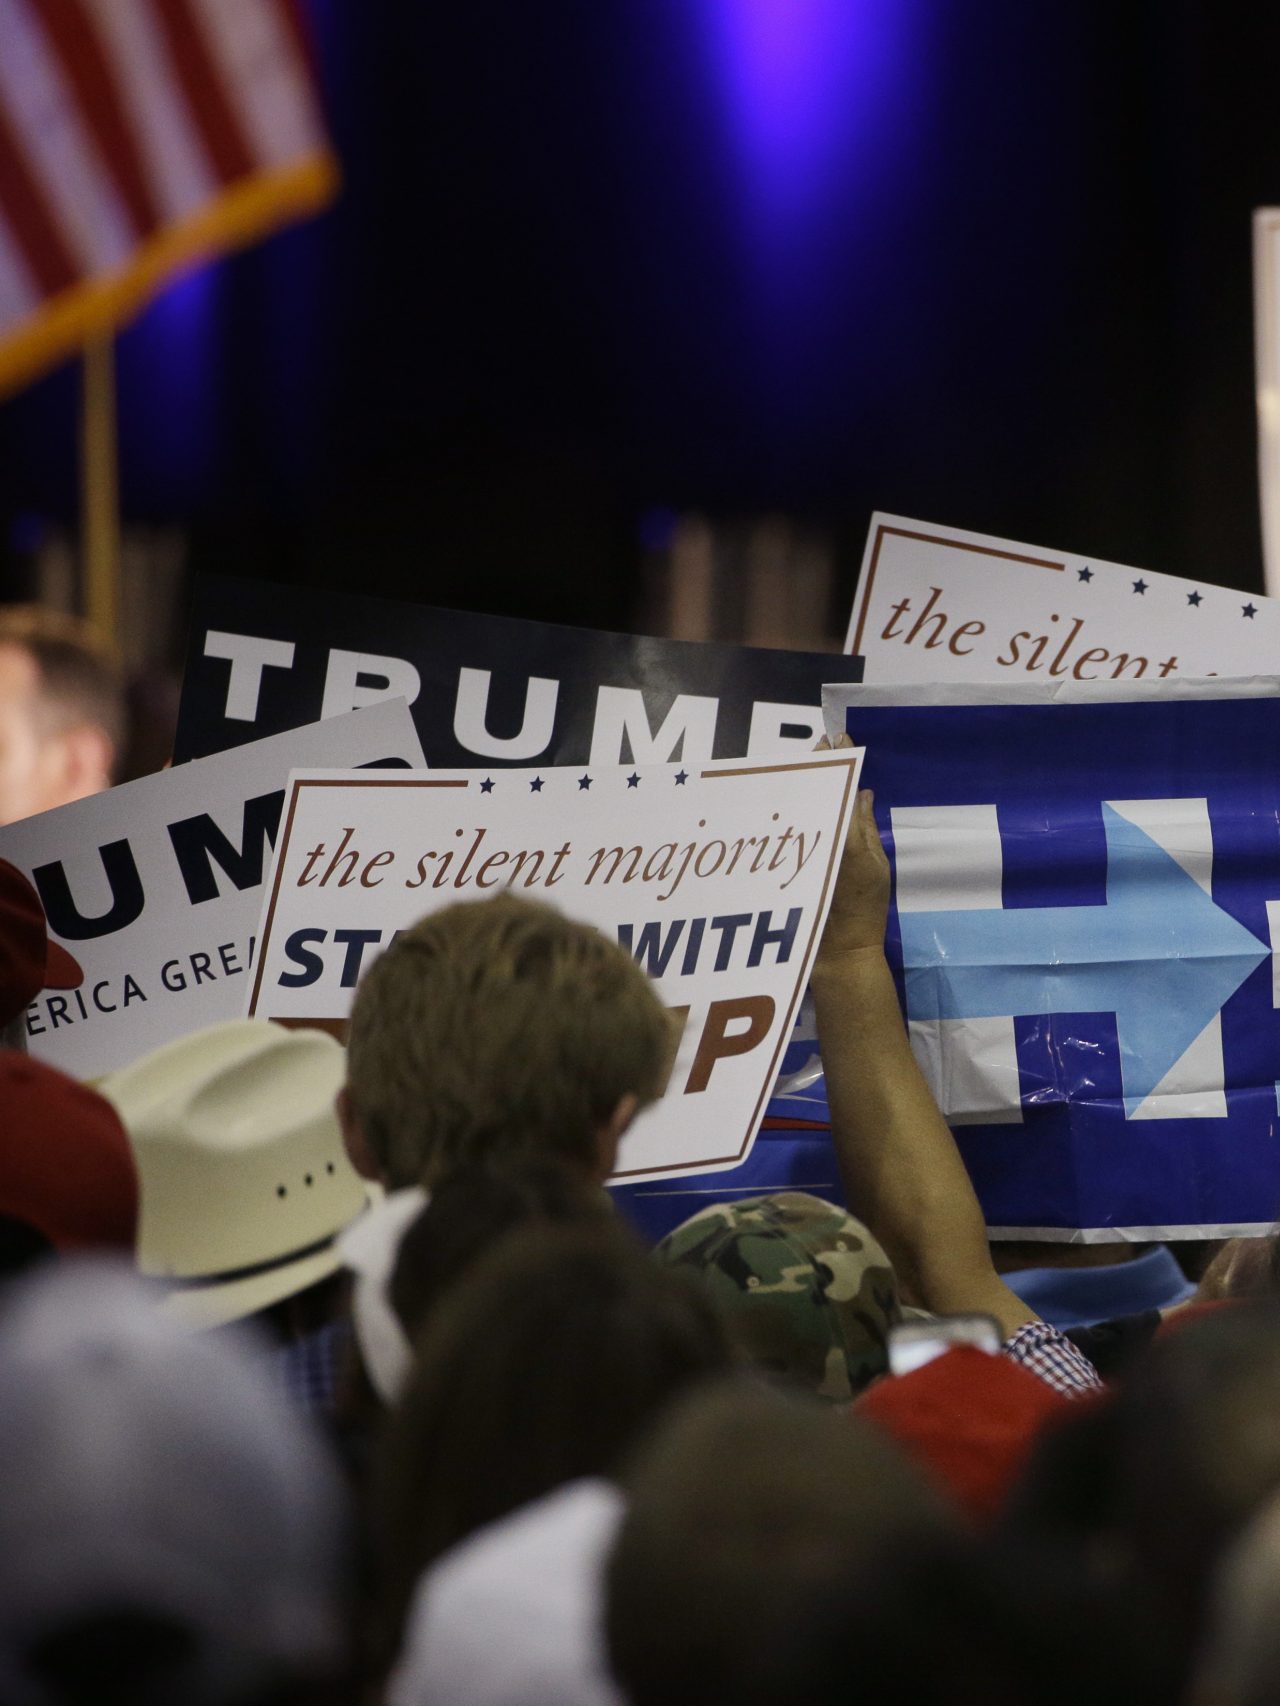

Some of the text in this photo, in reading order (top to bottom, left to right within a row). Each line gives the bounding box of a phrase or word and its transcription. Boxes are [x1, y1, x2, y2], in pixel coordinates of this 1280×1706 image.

[880, 586, 986, 656] the
[296, 812, 822, 901] the silent majority
[616, 906, 804, 979] WITH
[27, 973, 148, 1037] ERICA
[160, 936, 256, 992] GRE
